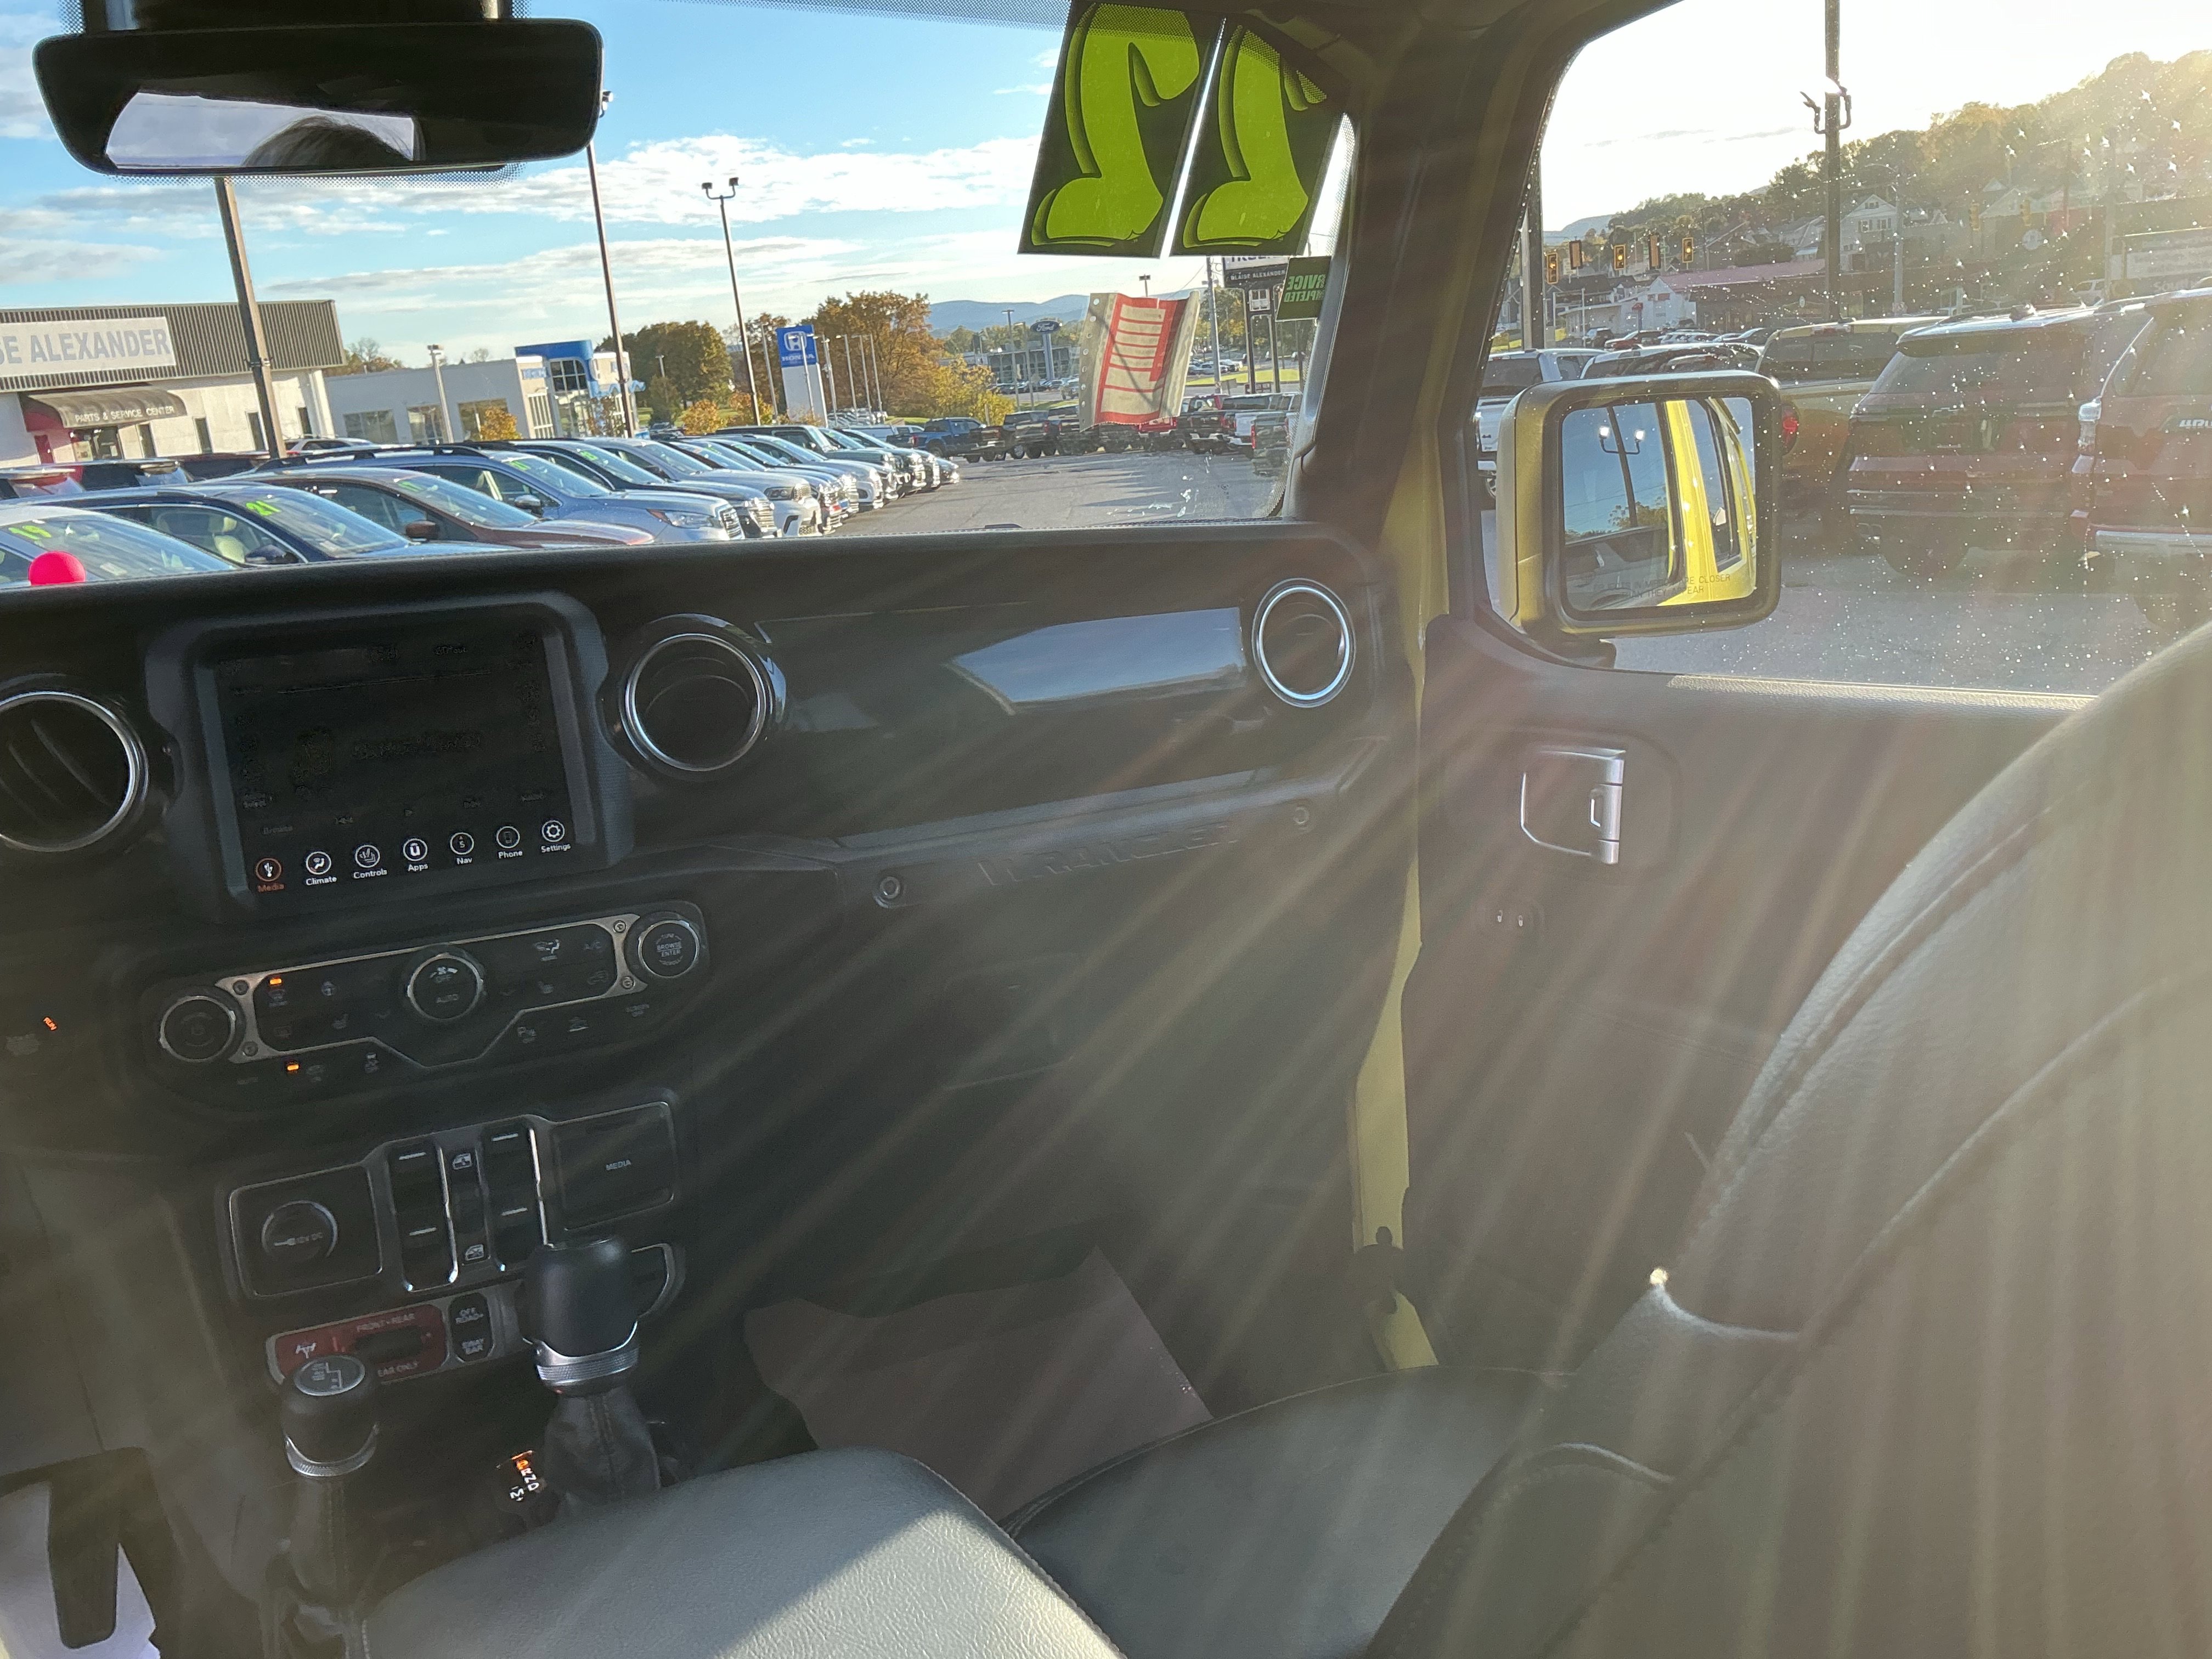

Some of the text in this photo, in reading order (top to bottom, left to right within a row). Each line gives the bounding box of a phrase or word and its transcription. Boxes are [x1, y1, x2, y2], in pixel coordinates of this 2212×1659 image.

[31, 329, 171, 363] ALEXANDER
[75, 405, 174, 423] PARTS & SERVICE CENTER
[1699, 573, 1731, 584] CLOSER
[541, 843, 571, 853] Settings
[498, 851, 523, 859] Phone
[456, 856, 473, 865] Nav
[408, 863, 428, 872] Apps
[353, 868, 388, 879] Controls
[306, 876, 337, 886] Climate
[257, 883, 284, 893] Media
[661, 949, 681, 957] ENTER
[606, 1159, 631, 1171] MEDIA
[377, 1365, 395, 1378] EAR
